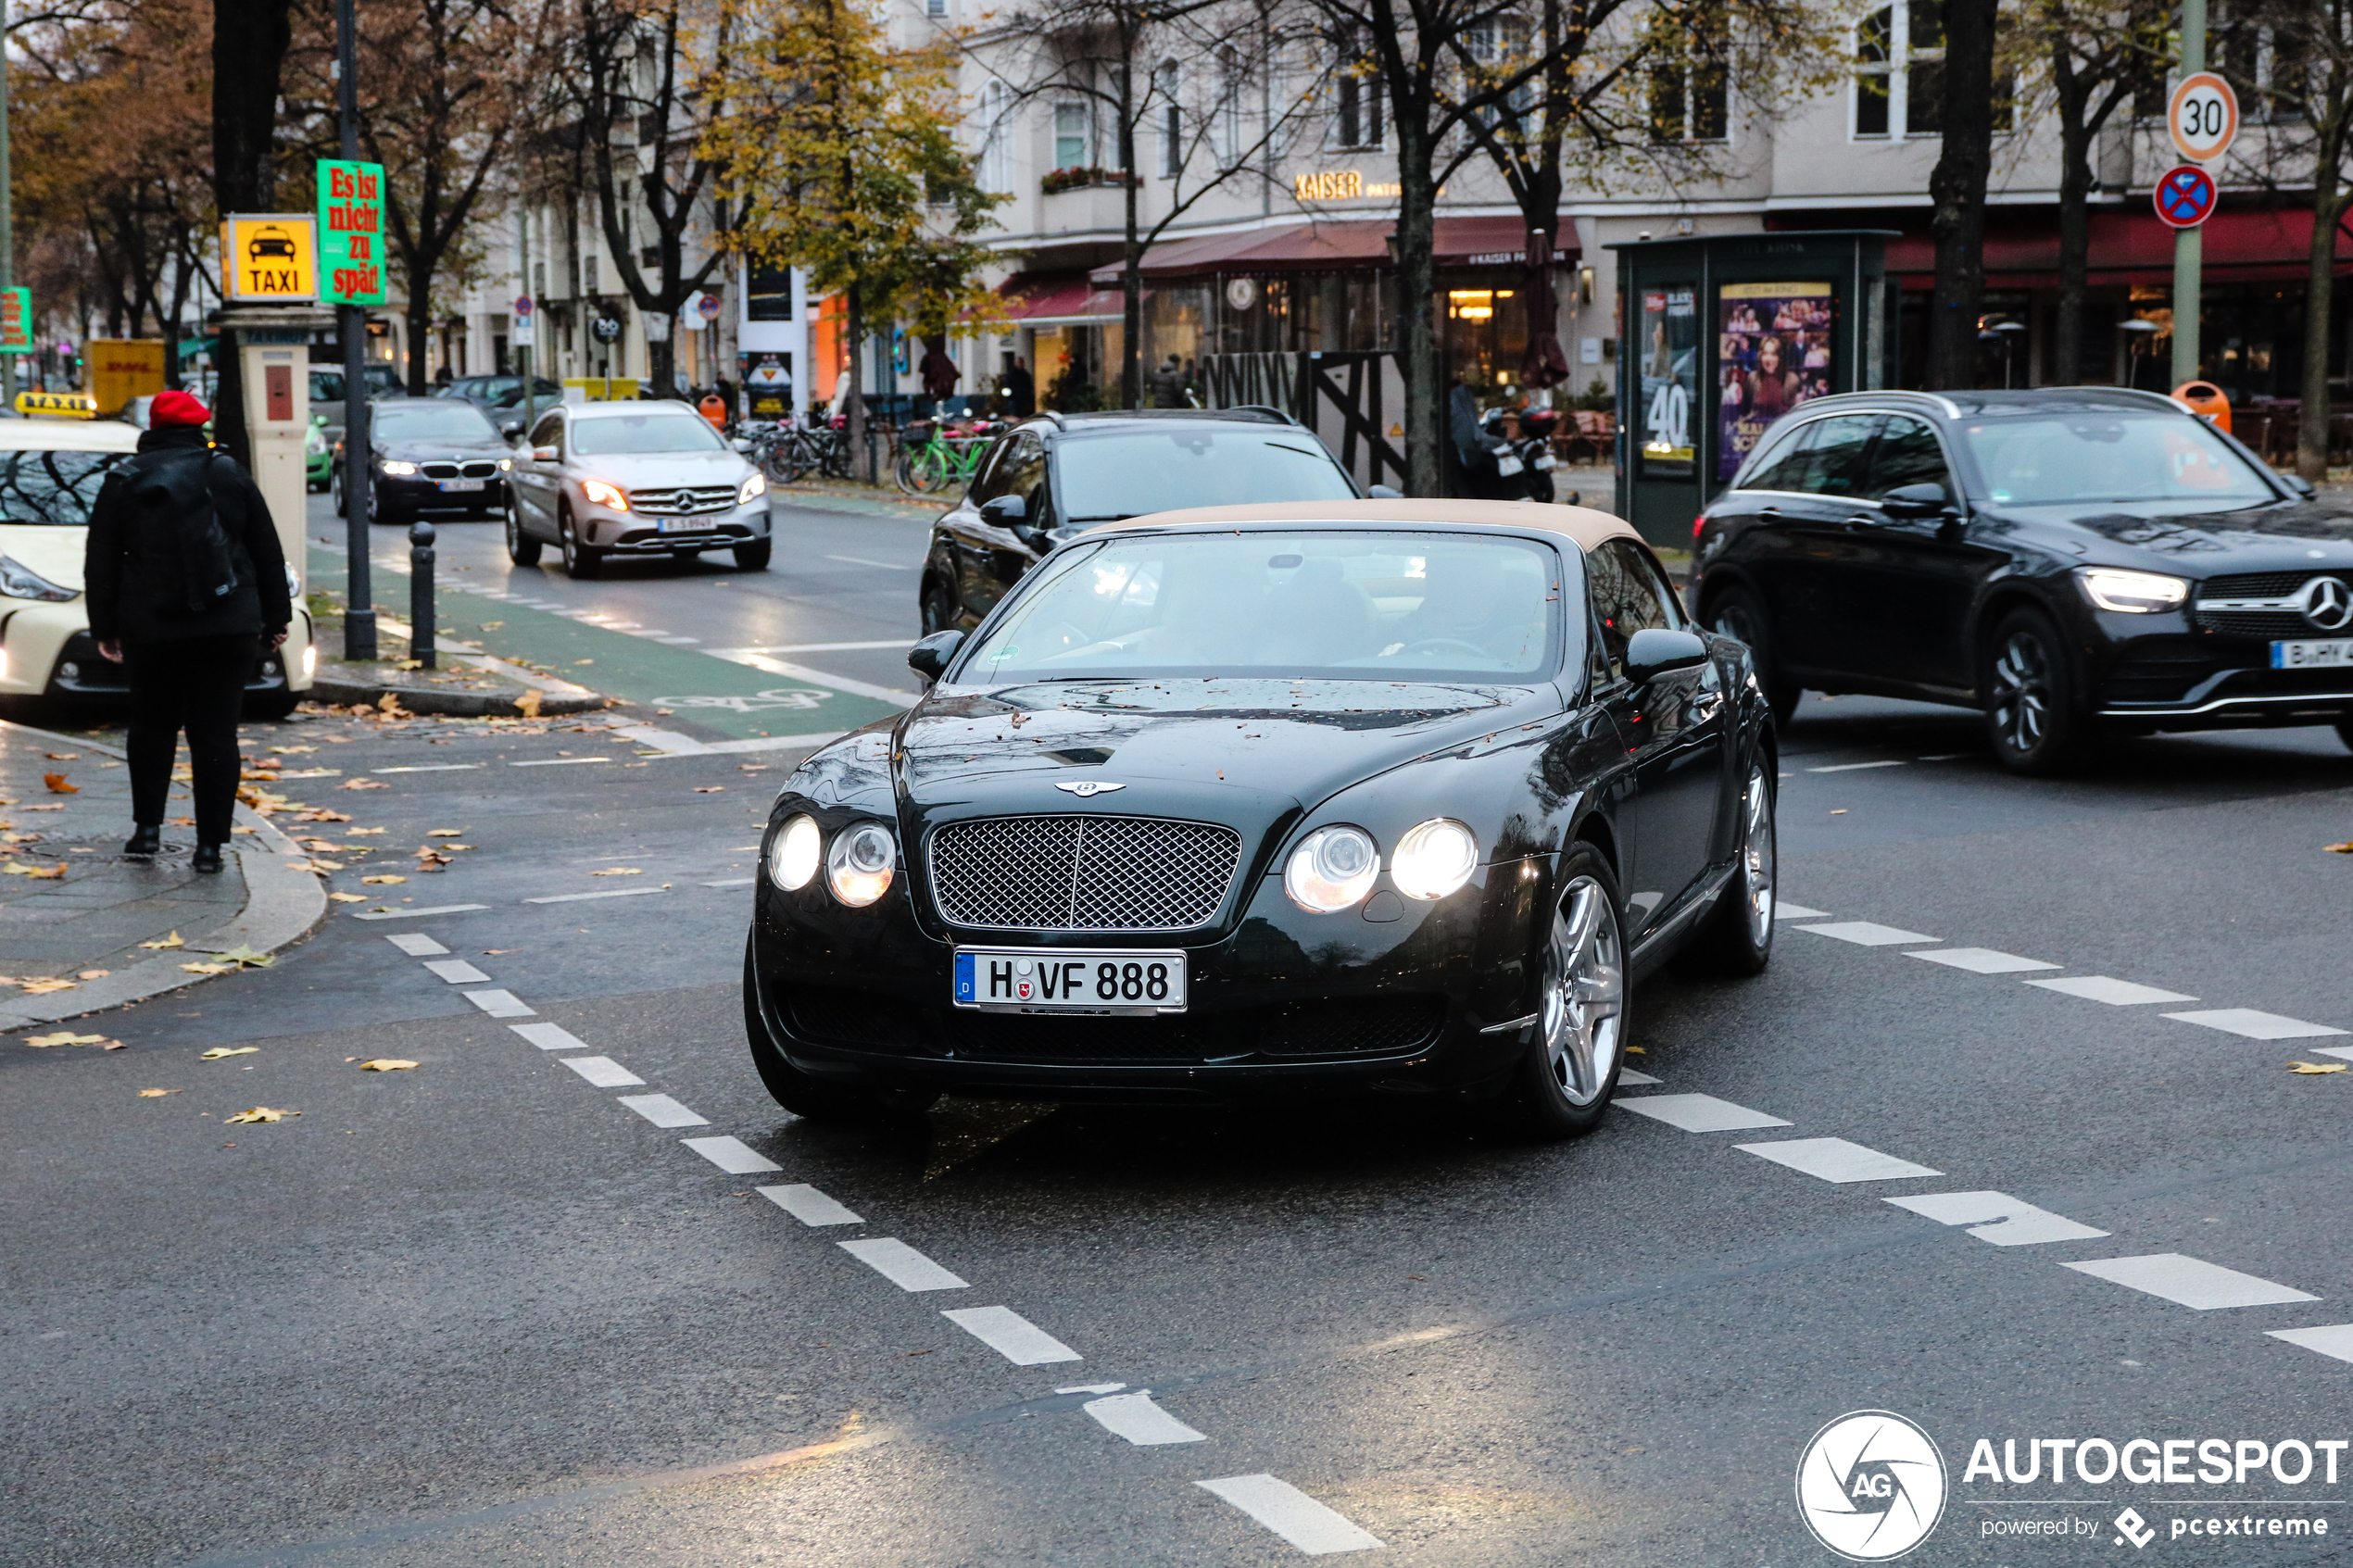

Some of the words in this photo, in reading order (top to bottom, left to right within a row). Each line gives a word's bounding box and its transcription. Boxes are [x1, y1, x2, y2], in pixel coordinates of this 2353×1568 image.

[2183, 98, 2222, 136] 30
[330, 167, 355, 198] Es
[357, 168, 378, 200] ist
[1296, 170, 1363, 201] KAISER
[328, 200, 379, 232] nicht
[348, 234, 371, 260] zu
[249, 270, 298, 292] TAXI
[1647, 383, 1689, 448] 40
[2292, 645, 2306, 664] B
[962, 983, 970, 994] D
[989, 960, 1013, 998] H
[1037, 961, 1086, 1000] VF
[1096, 961, 1169, 1000] 888
